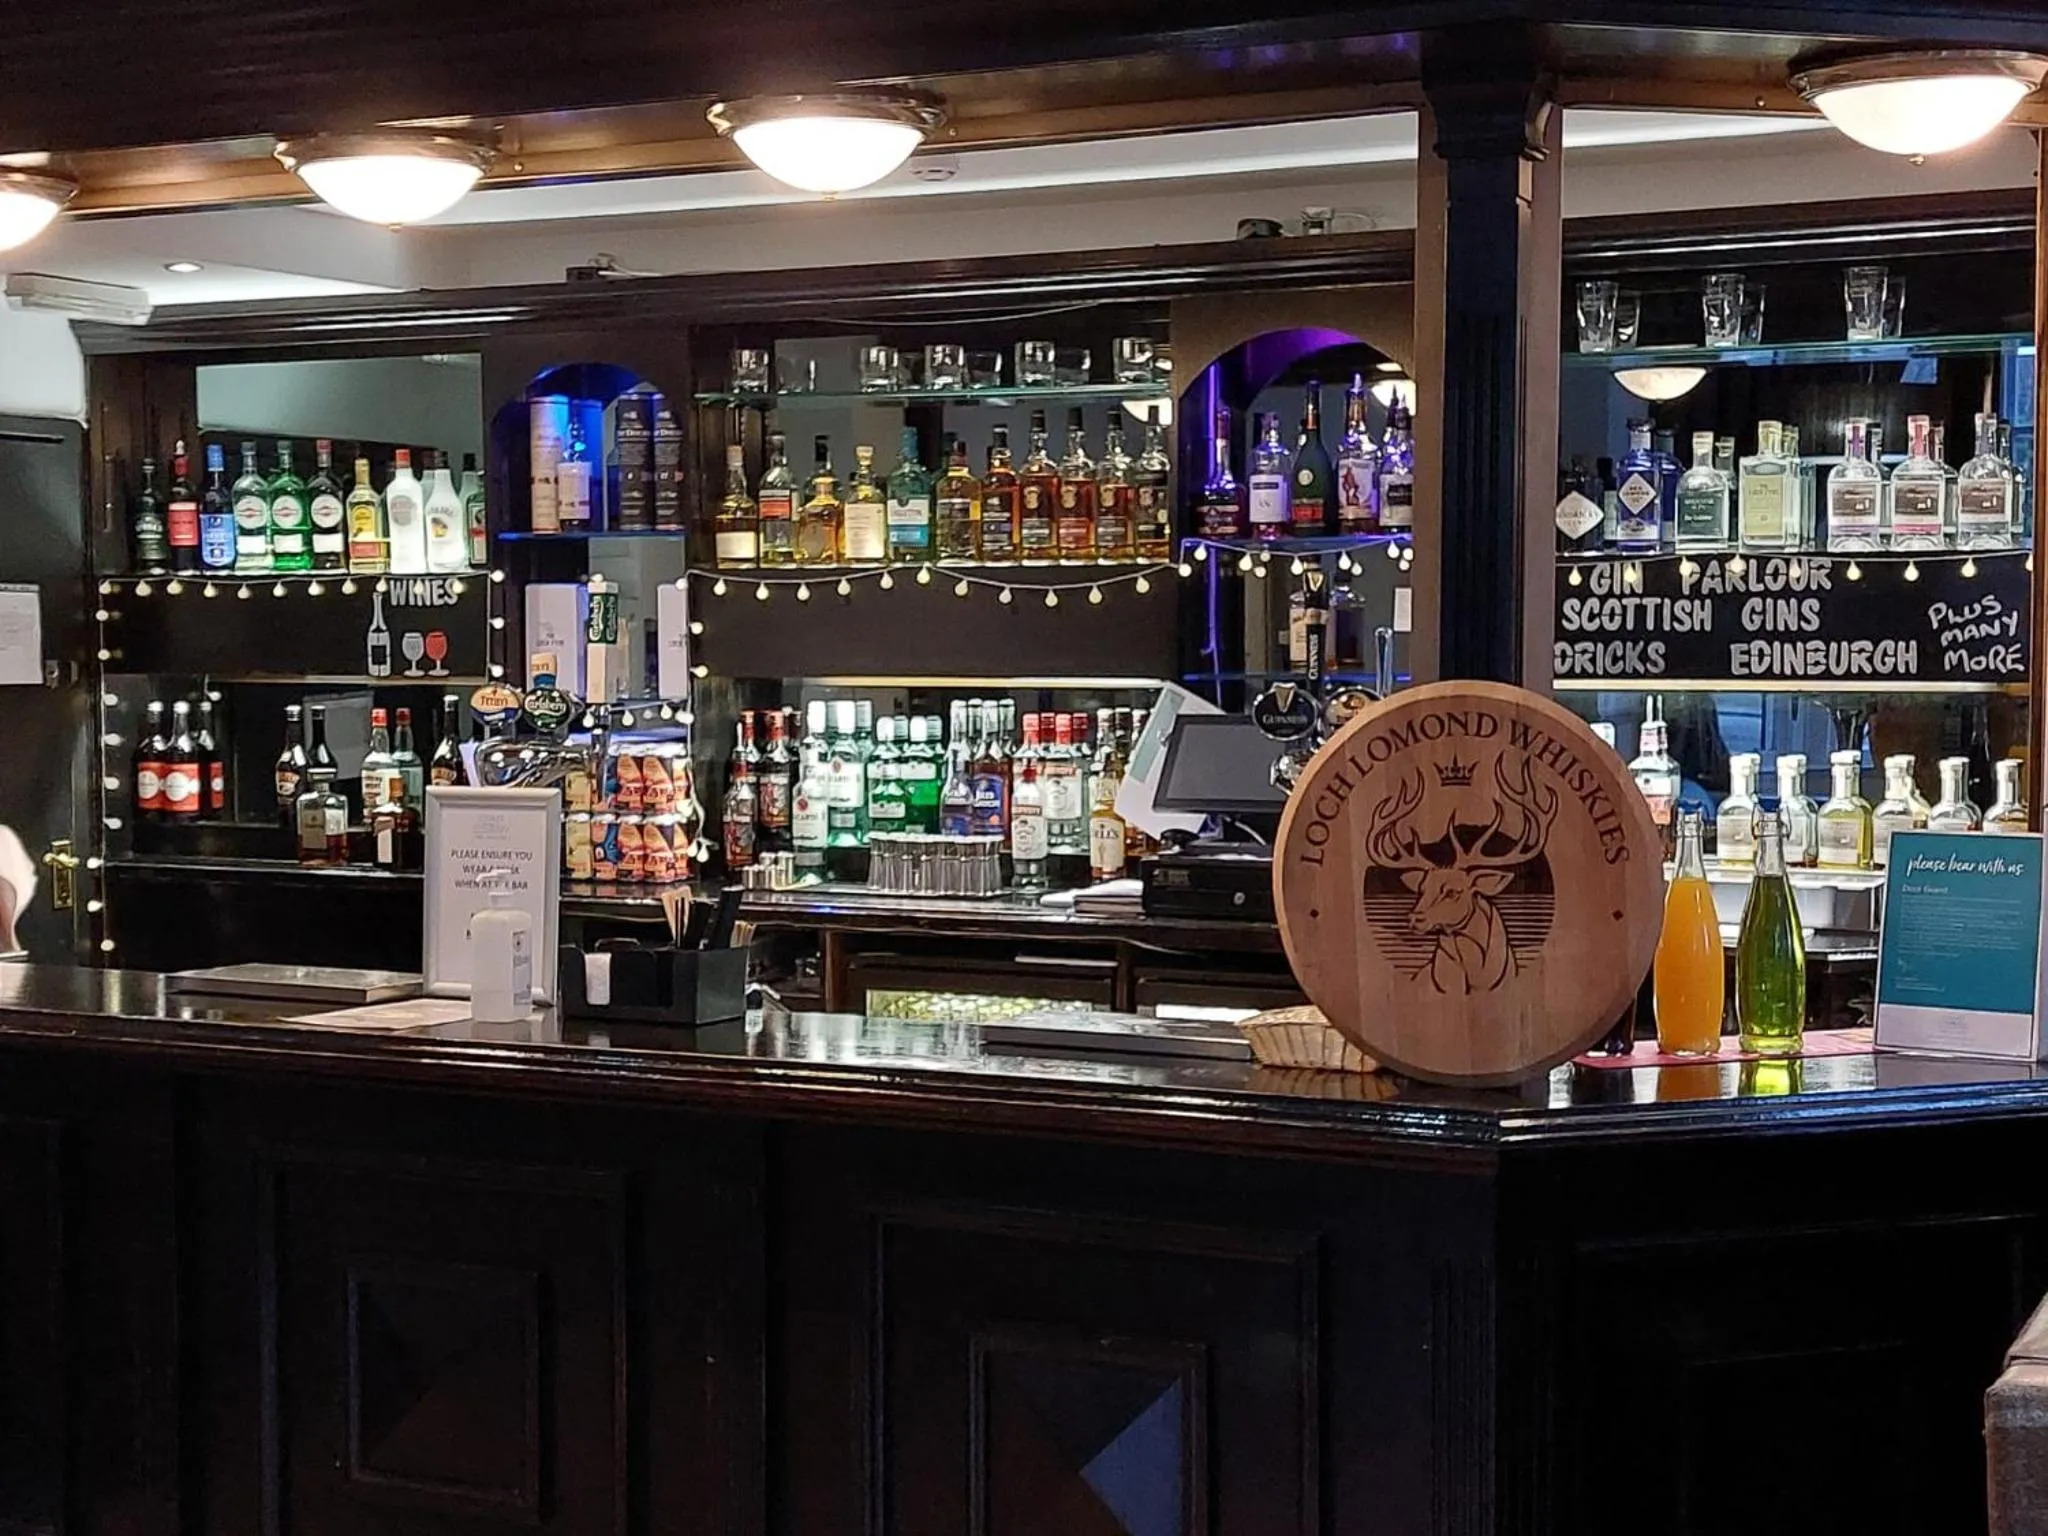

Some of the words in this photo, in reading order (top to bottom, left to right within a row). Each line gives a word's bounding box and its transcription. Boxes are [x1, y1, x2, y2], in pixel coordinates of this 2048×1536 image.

[389, 579, 460, 607] WINES
[1590, 560, 1643, 594] GIN
[1683, 558, 1833, 594] PARLOUR
[1562, 598, 1712, 632] SCOTTISH
[1741, 598, 1821, 632] GINS
[1928, 594, 2002, 630] PLUS
[1941, 610, 2020, 648] MANY
[1730, 640, 1919, 676] EDINBURGH
[1300, 776, 1355, 867] LOCH
[1348, 711, 1498, 778] LOMOND
[1507, 719, 1631, 867] WHISKIES
[451, 848, 479, 859] PLEASE
[481, 850, 512, 860] ENSURE
[515, 851, 533, 861] YOU
[1906, 852, 1946, 877] please
[1948, 852, 1975, 872] bear
[1978, 856, 2005, 875] with
[2007, 863, 2024, 876] us
[455, 879, 480, 888] WHEN
[512, 881, 528, 890] BAR
